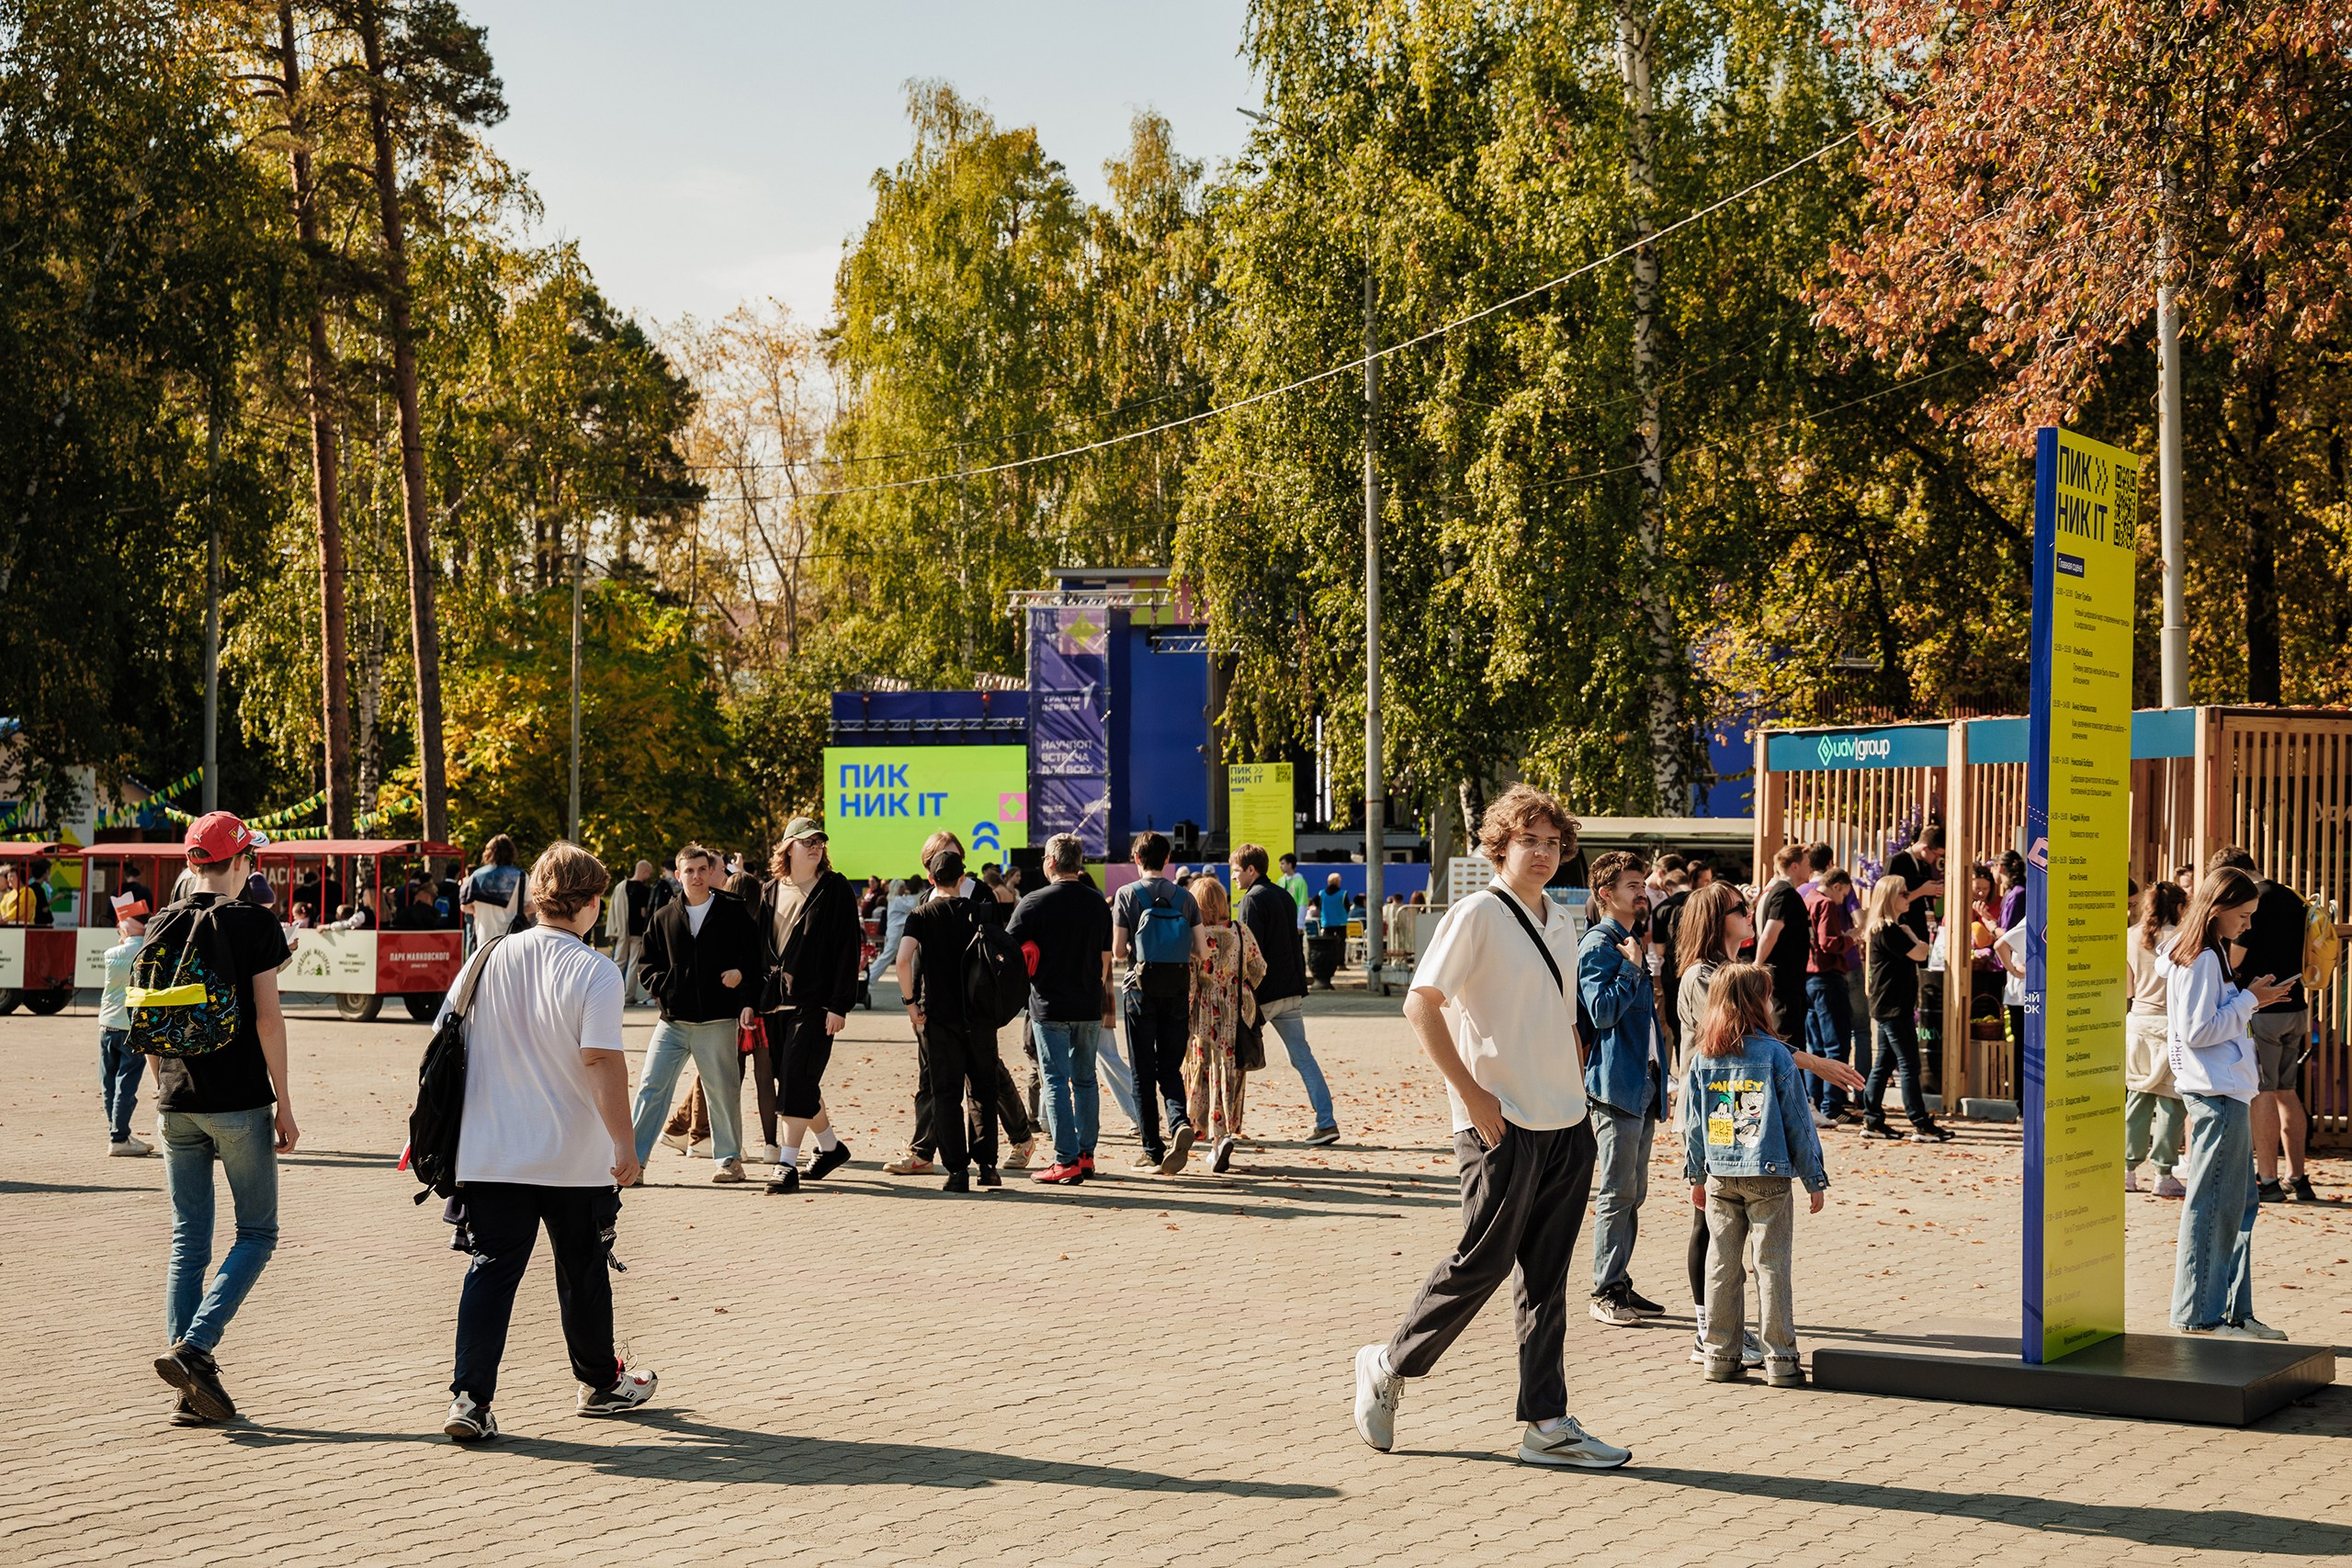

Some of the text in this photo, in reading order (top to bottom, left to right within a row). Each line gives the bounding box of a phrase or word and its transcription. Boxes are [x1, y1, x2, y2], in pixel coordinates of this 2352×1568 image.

[2058, 445, 2092, 492] ПИК
[2057, 491, 2109, 542] НИК IT
[1041, 739, 1092, 750] НАУЧПОП
[1041, 752, 1090, 762] ВСТРЕЧА
[1066, 764, 1093, 775] ВСЕХ
[1230, 766, 1251, 774] ПИК
[840, 764, 910, 788] ПИК
[1230, 775, 1263, 784] НИК IT
[841, 793, 948, 817] НИК IT
[1709, 1079, 1764, 1092] MICKEY
[1711, 1122, 1732, 1131] HIDE
